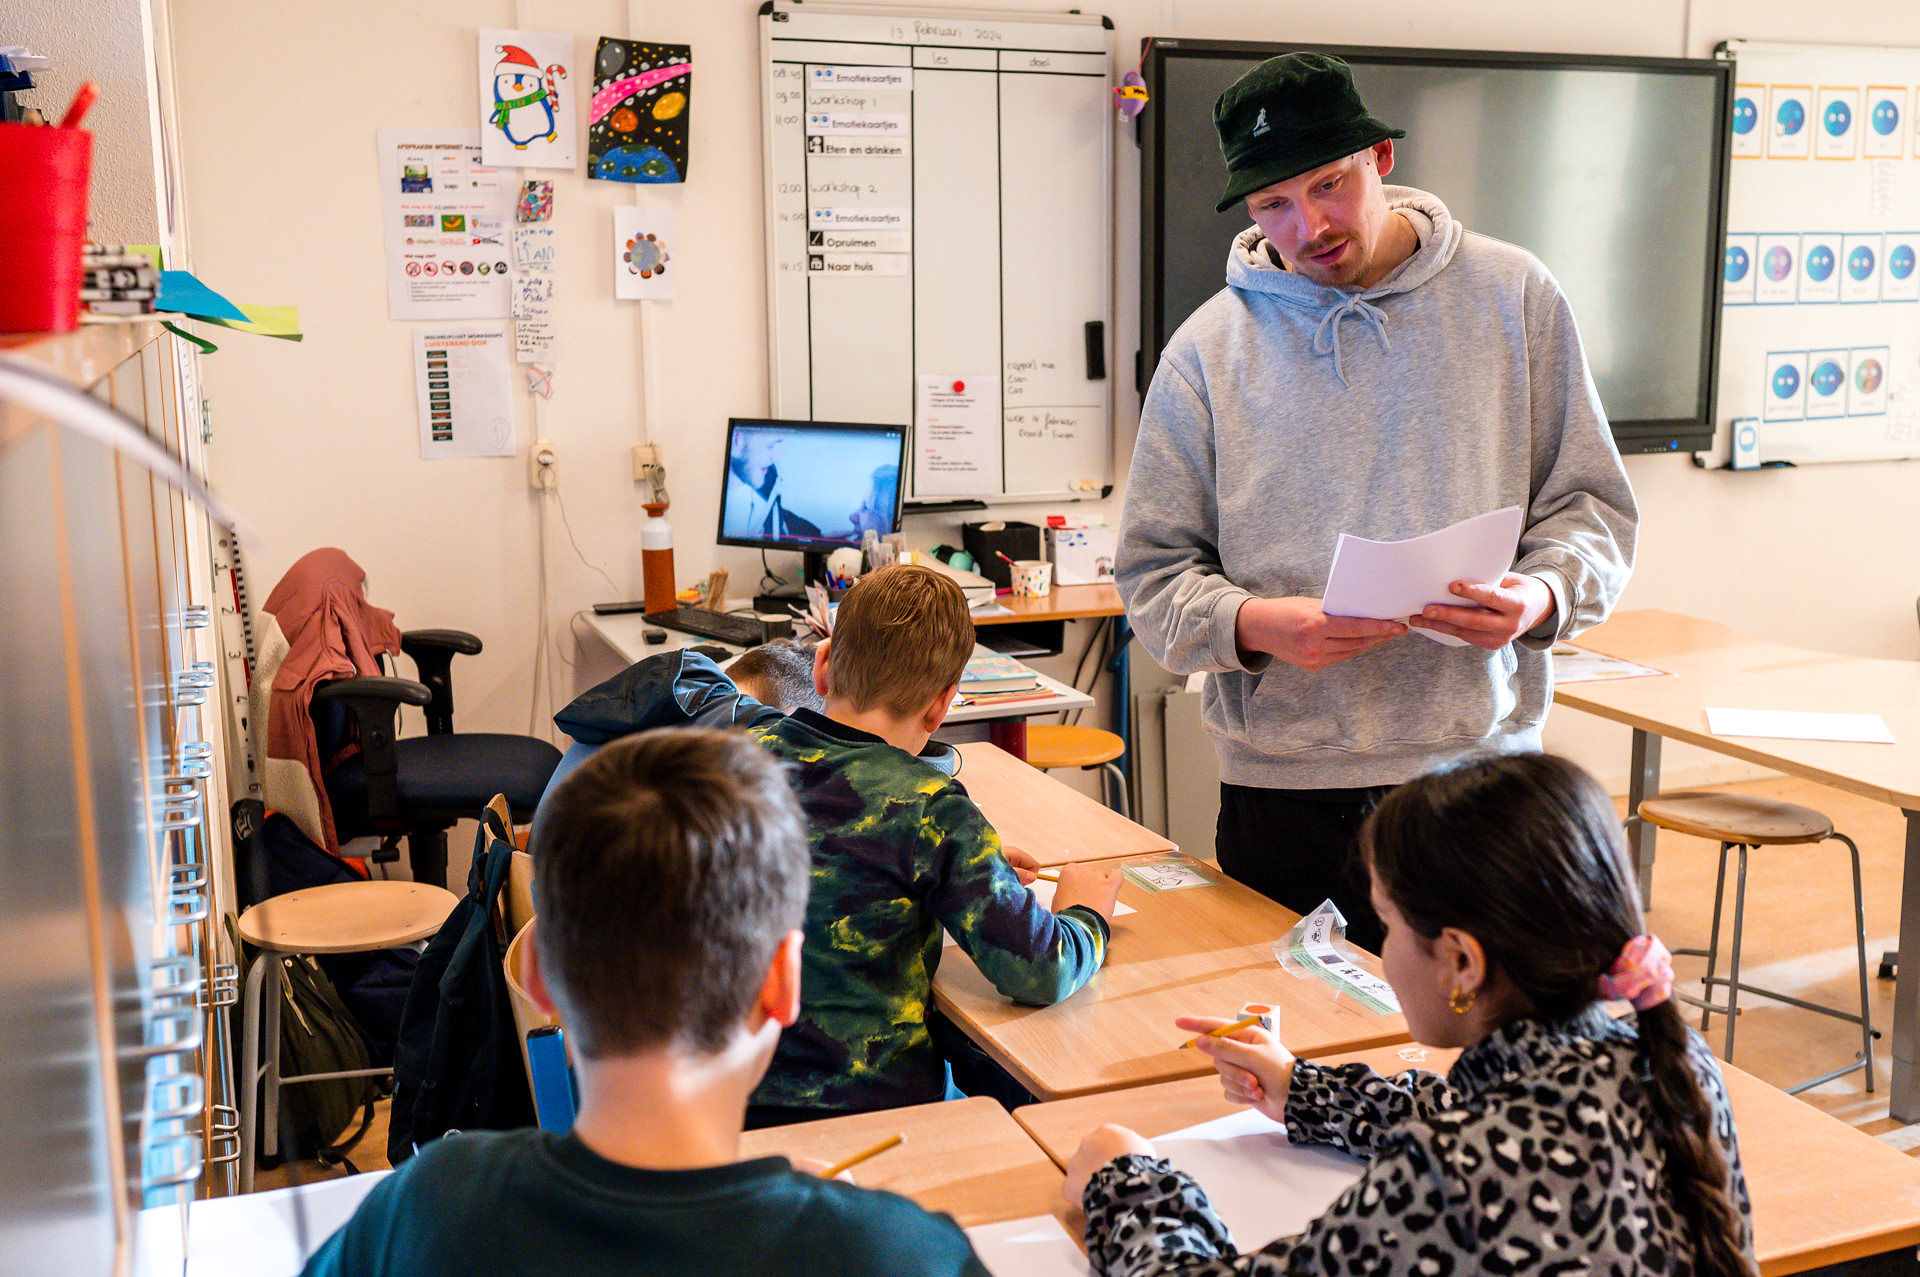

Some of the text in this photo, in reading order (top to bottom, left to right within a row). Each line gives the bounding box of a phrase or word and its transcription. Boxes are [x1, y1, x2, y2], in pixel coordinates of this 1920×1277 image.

[890, 20, 1002, 42] 13 februari 2024
[1029, 57, 1051, 67] doel
[836, 73, 902, 84] Emotiekaartjes
[831, 119, 898, 130] Emotiekaartjes
[826, 144, 902, 154] Eten en drinken
[868, 185, 878, 193] 2
[835, 213, 901, 224] Emotiekaartjes
[826, 238, 877, 248] Opruimen
[827, 260, 874, 271] Naar huis
[221, 605, 235, 616] 2
[228, 650, 242, 660] 3
